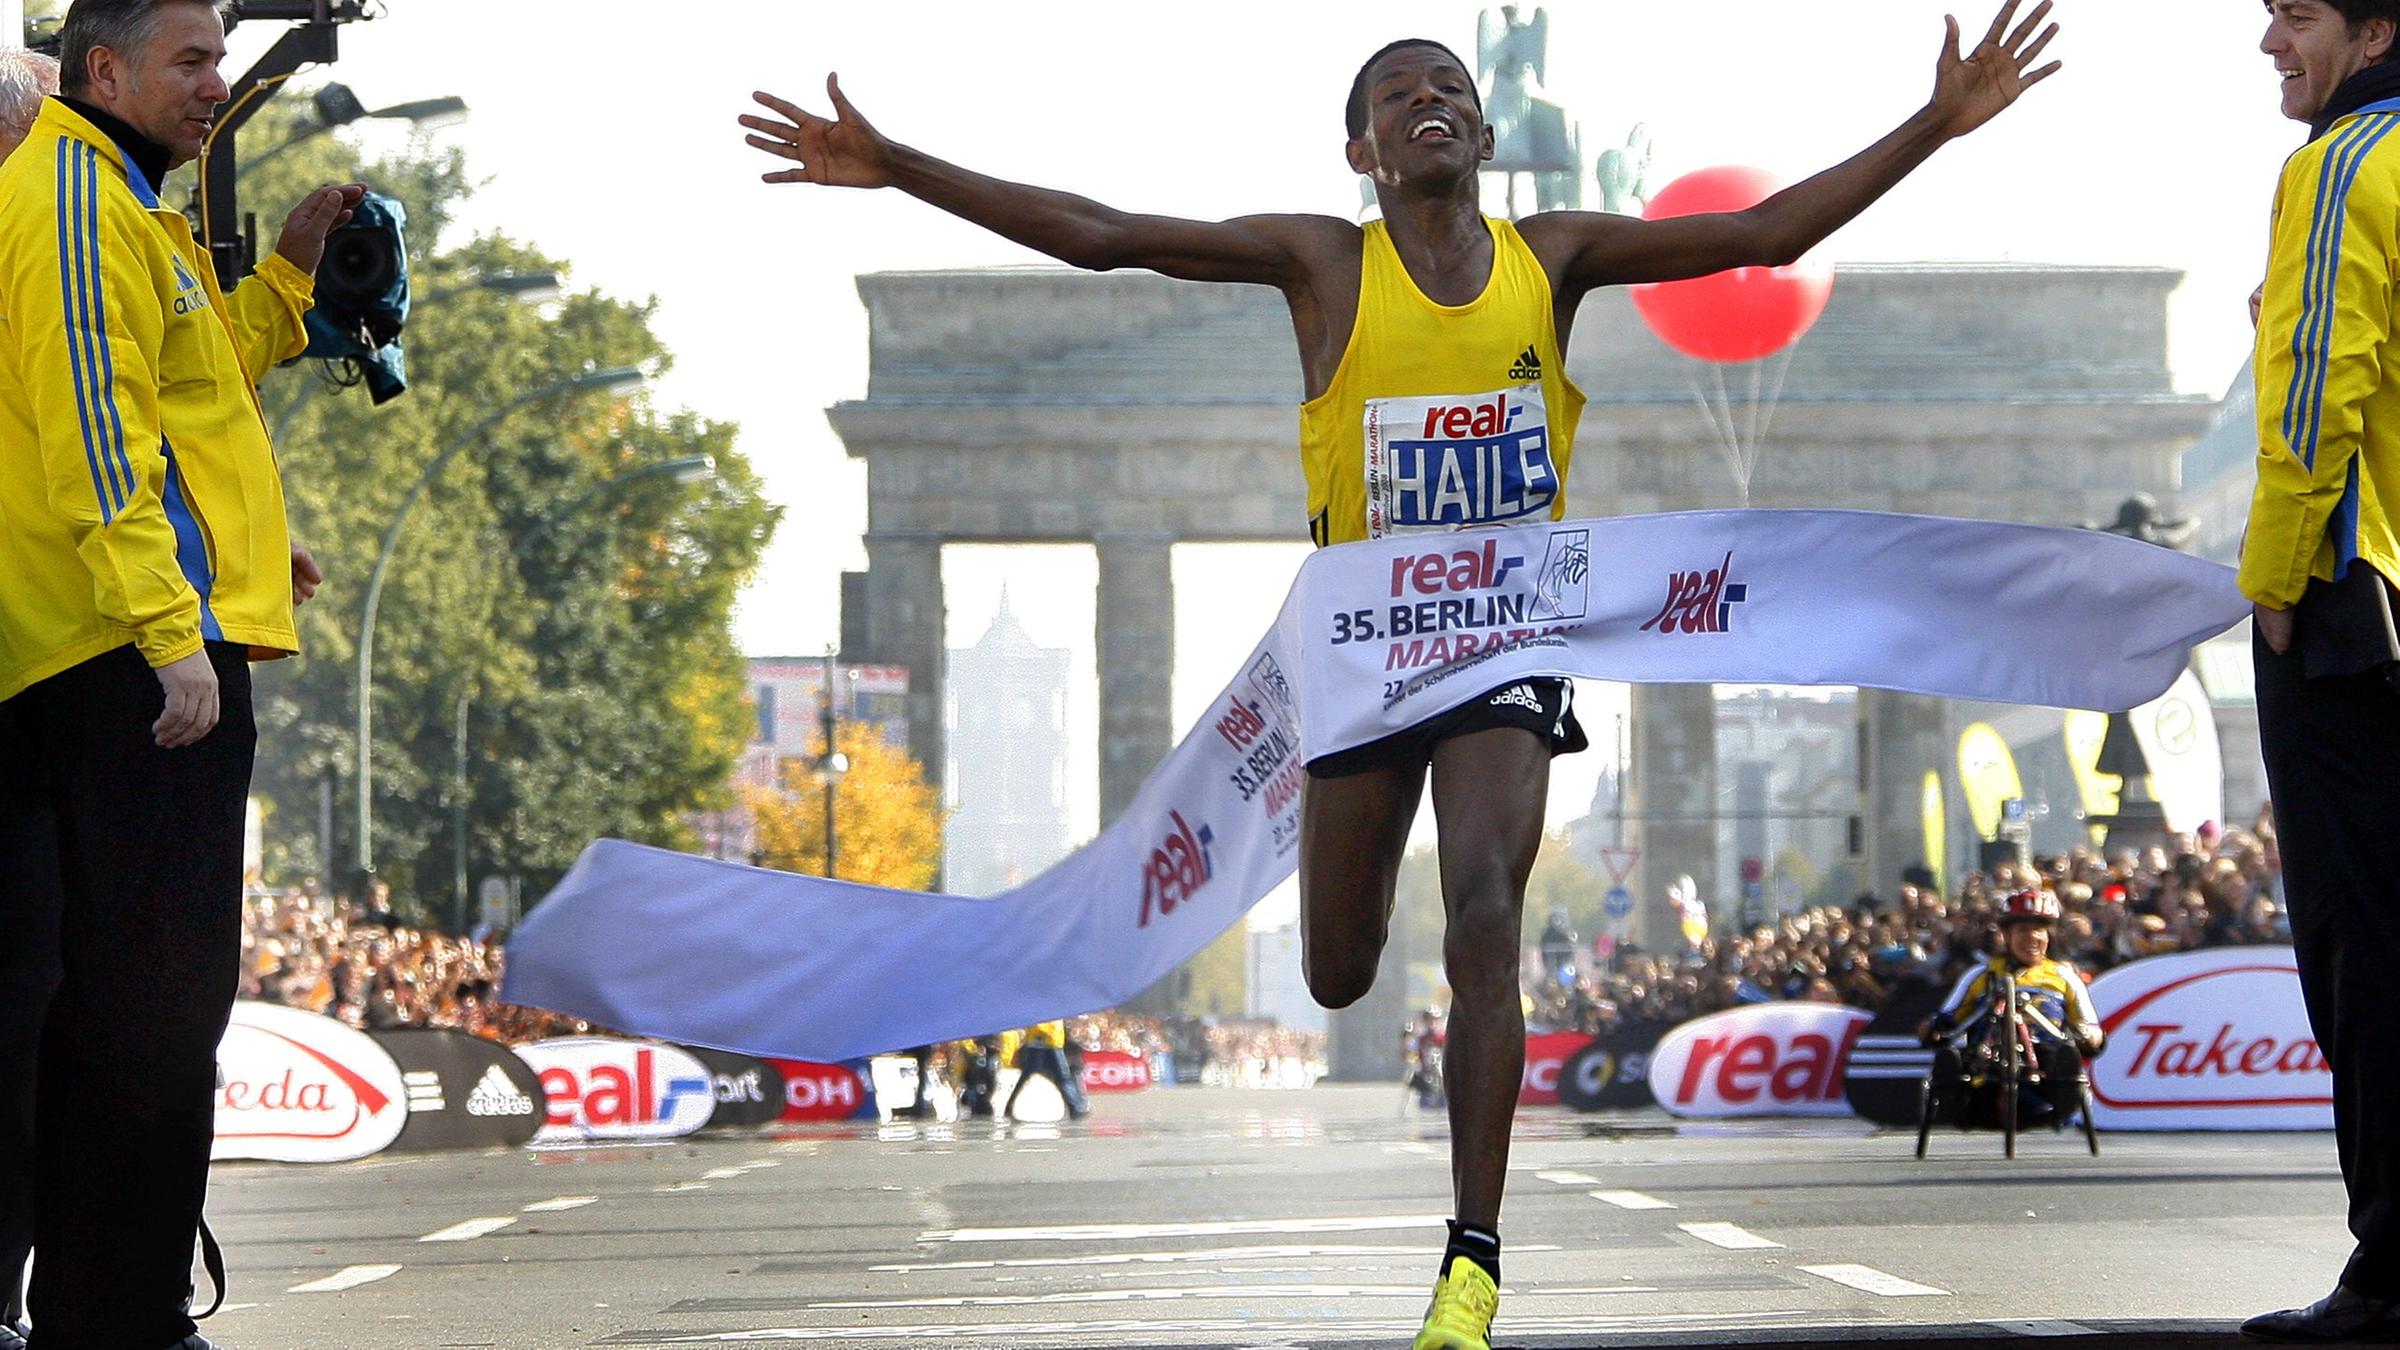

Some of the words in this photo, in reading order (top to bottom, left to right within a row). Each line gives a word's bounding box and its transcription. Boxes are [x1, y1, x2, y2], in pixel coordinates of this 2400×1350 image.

[1390, 435, 1551, 521] HAILE
[1330, 609, 1385, 645] 35.
[1389, 593, 1525, 637] BERLIN
[1489, 693, 1543, 713] adidas
[1247, 726, 1290, 783] BERLIN
